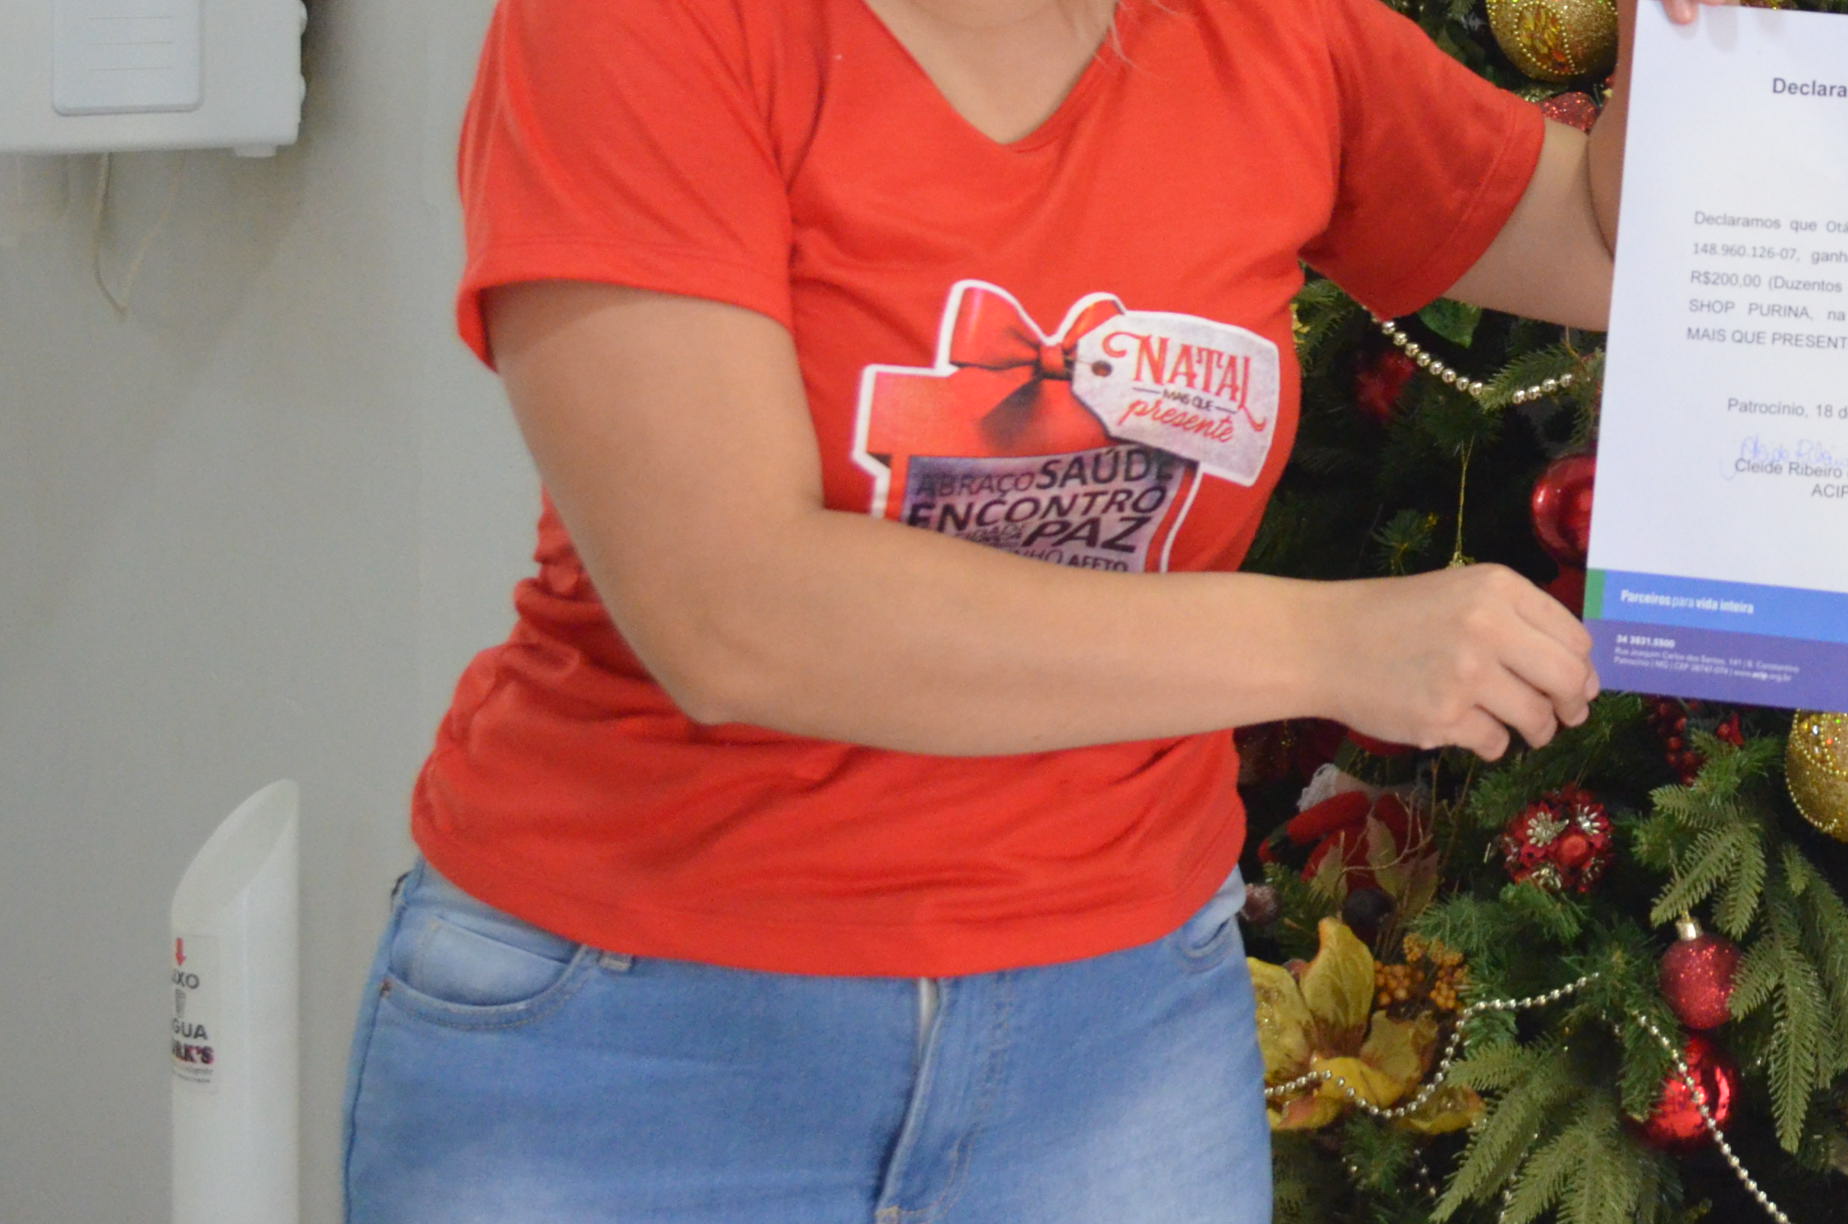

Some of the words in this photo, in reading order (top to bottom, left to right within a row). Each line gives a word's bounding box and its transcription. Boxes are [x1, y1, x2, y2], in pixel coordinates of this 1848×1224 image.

[1694, 210, 1782, 230] Declaramos
[1789, 219, 1817, 233] que
[1690, 269, 1762, 288] R$200,00
[1768, 274, 1843, 293] (Duzentos
[1688, 298, 1736, 314] SHOP
[1748, 302, 1814, 321] PURINA,
[1827, 309, 1846, 322] na
[1686, 326, 1727, 343] MAIS
[1731, 329, 1767, 345] QUE
[1727, 397, 1808, 418] Patrocínio,
[1816, 403, 1833, 418] 18
[1117, 399, 1234, 442] presente
[916, 470, 1034, 499] ABRAÇO
[1035, 448, 1176, 490] SAÚDE
[1735, 457, 1783, 475] Cleide
[1788, 461, 1843, 478] Ribeiro
[907, 485, 1168, 533] ENCONTRO
[1020, 515, 1151, 554] PAZ
[1696, 597, 1718, 611] vida
[171, 969, 200, 990] XO
